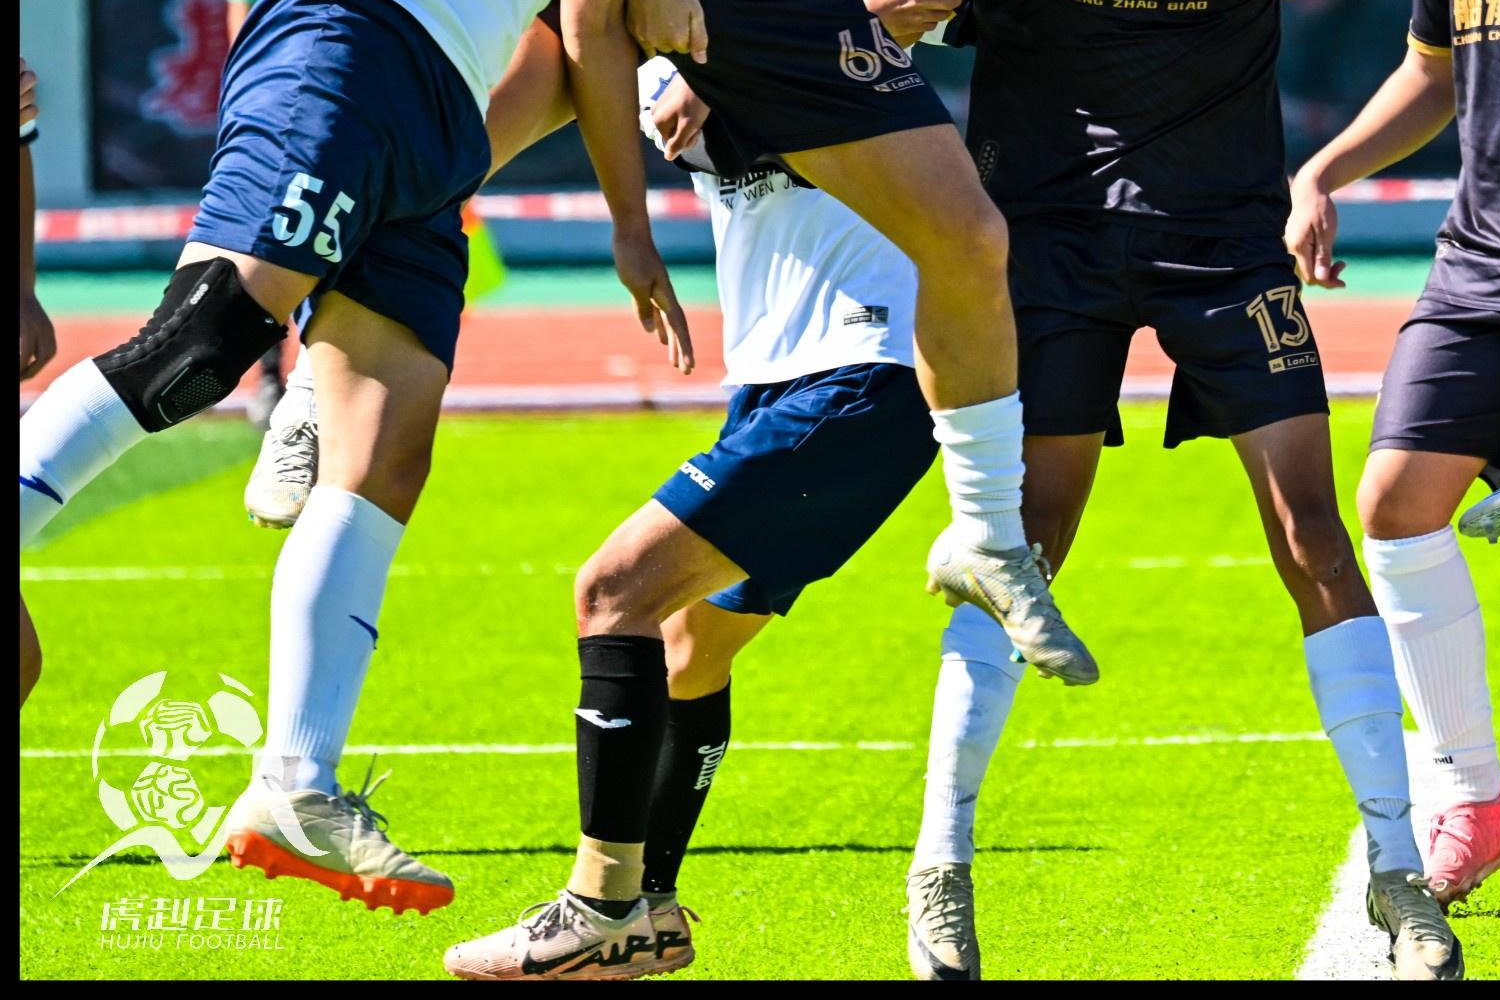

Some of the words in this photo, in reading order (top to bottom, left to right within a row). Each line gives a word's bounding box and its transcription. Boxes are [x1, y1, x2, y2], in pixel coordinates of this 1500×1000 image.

[1112, 0, 1157, 9] ZHAO
[1167, 1, 1208, 10] BIAO
[838, 16, 912, 82] 66
[272, 172, 356, 264] 55
[1245, 285, 1309, 354] 13
